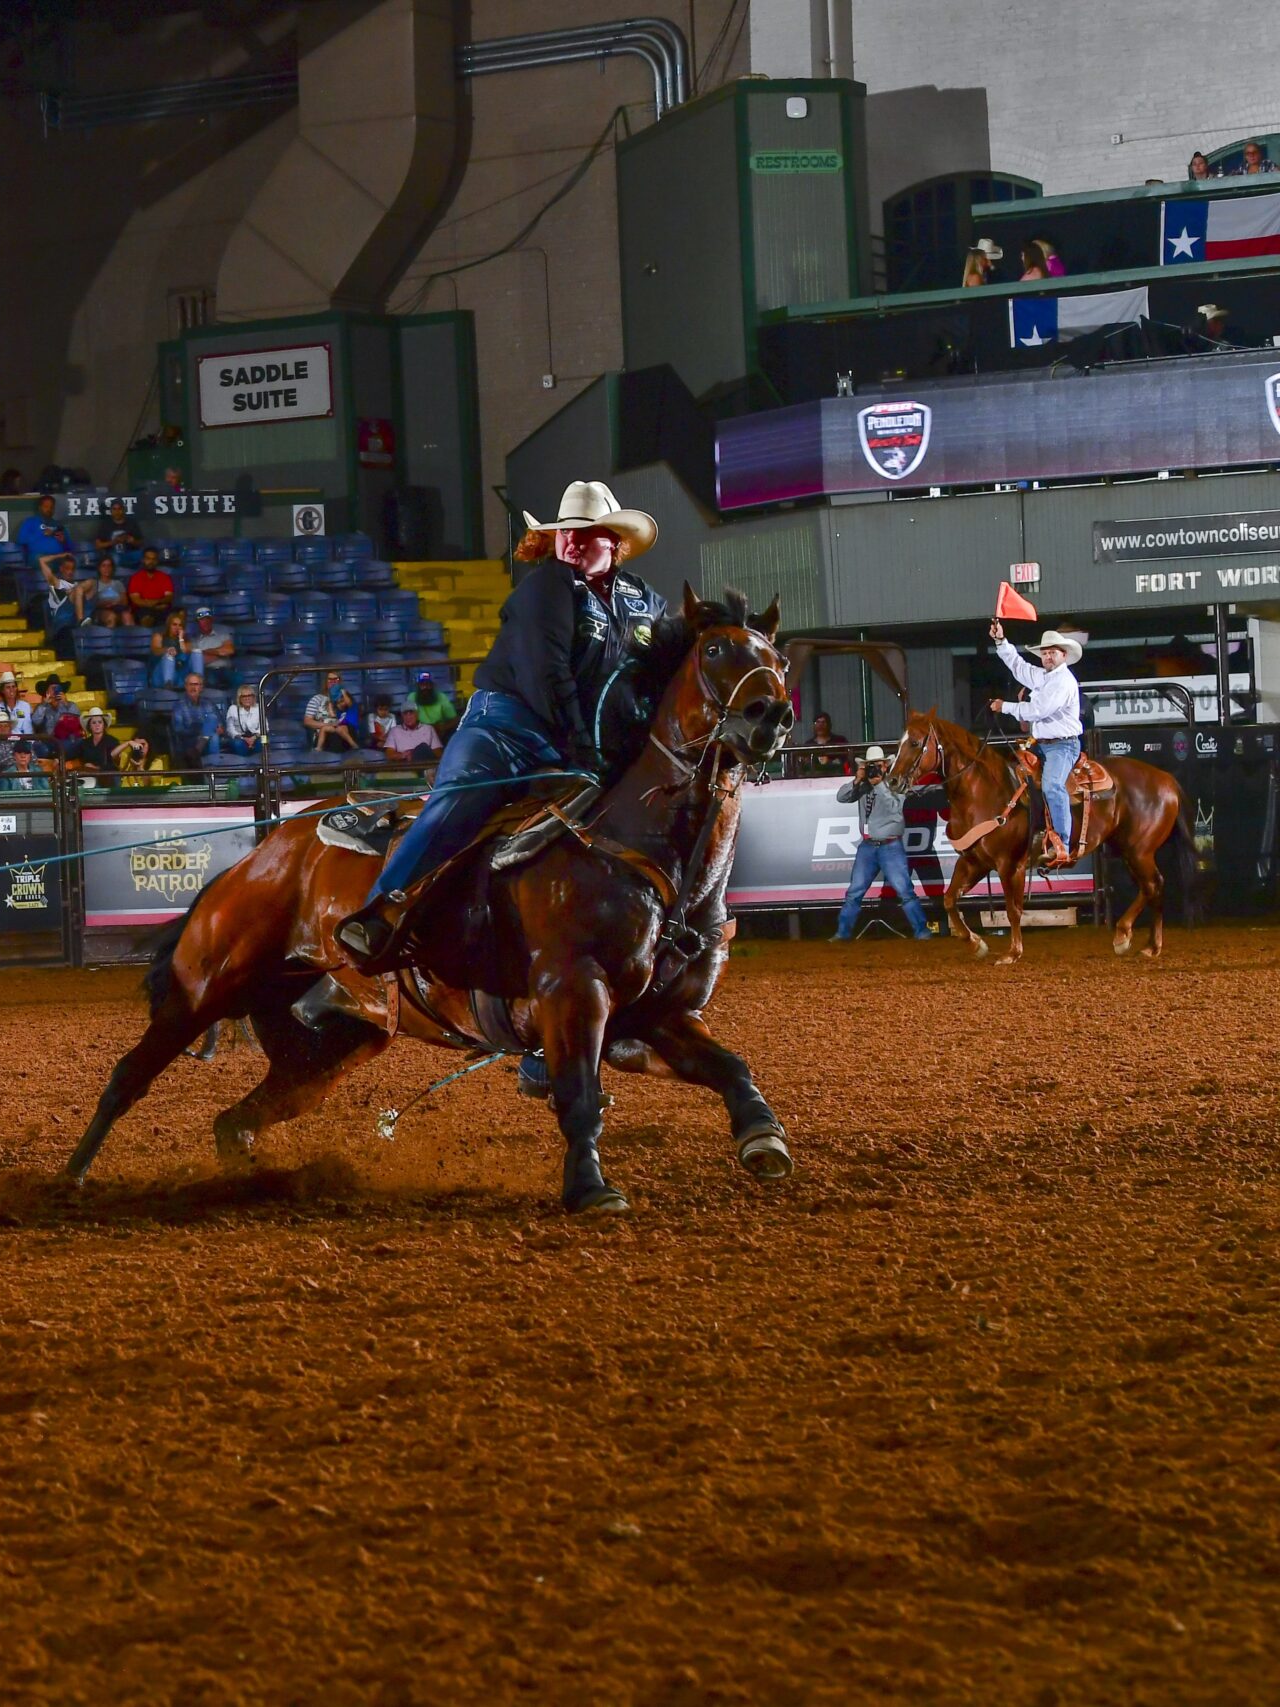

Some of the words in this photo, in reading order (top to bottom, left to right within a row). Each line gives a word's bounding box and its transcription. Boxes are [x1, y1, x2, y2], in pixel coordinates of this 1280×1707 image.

[755, 155, 838, 169] RESTROOMS
[219, 360, 309, 387] SADDLE
[232, 388, 298, 412] SUITE
[154, 495, 236, 515] SUITE
[1015, 564, 1035, 582] EXIT
[1135, 571, 1202, 593] FORT
[1216, 566, 1280, 588] WOR
[133, 852, 209, 871] BORDER
[15, 874, 41, 884] TRIPLE
[11, 882, 45, 896] CROWN
